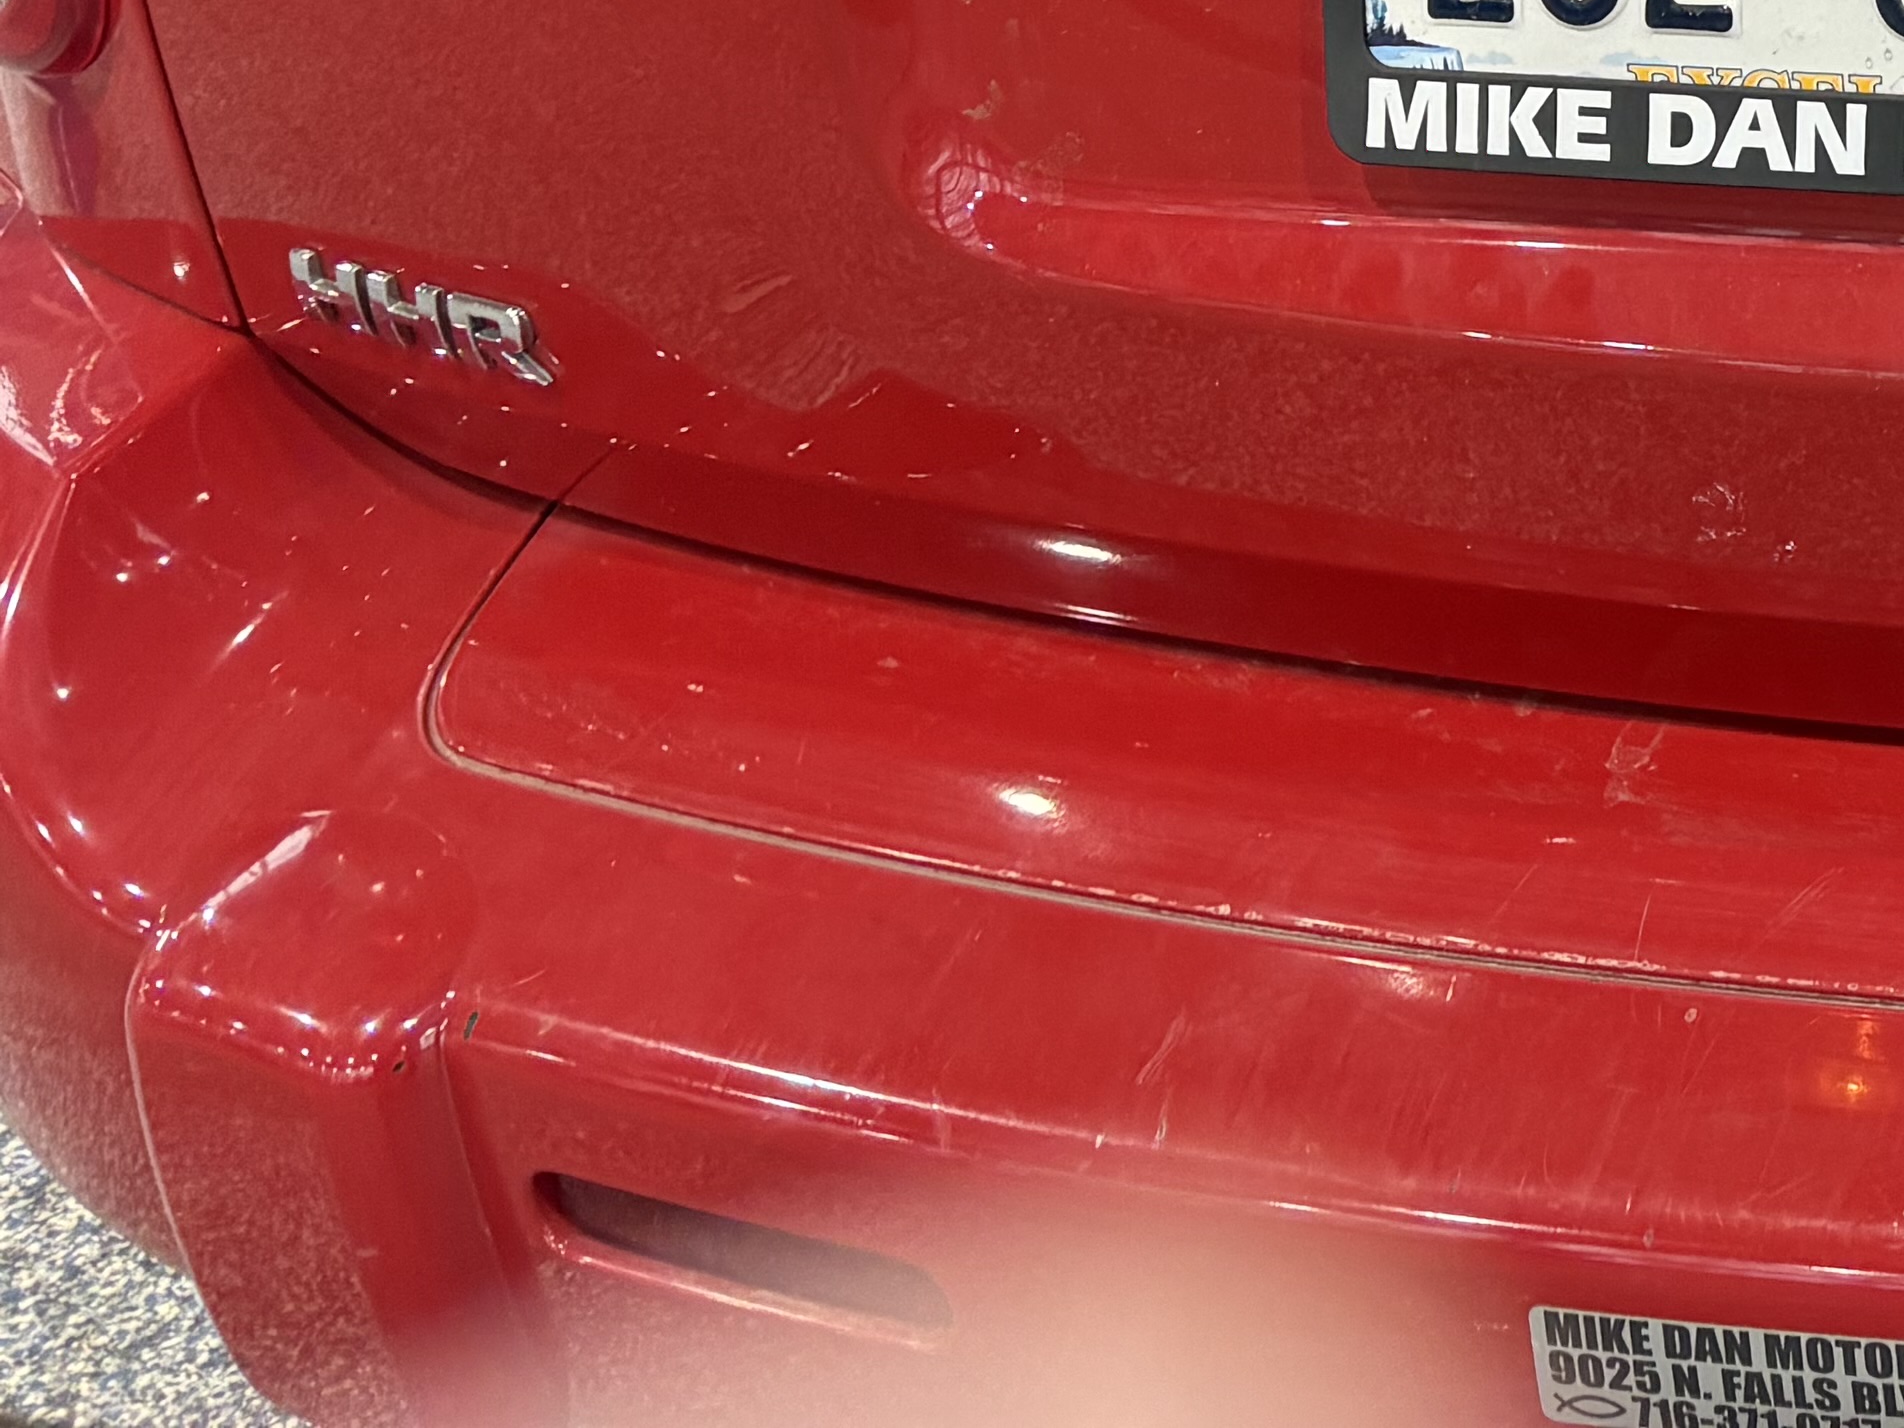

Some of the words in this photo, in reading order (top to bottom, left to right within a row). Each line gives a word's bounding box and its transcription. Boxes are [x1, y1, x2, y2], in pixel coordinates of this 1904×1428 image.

[1364, 76, 1613, 164] MIKE
[1646, 92, 1869, 179] DAN
[288, 247, 554, 386] HHR
[1542, 1309, 1654, 1357] MIKE
[1661, 1322, 1754, 1368] DAN
[1547, 1349, 1662, 1396] 9025
[1673, 1364, 1714, 1401] N.
[1720, 1367, 1841, 1414] FALLS
